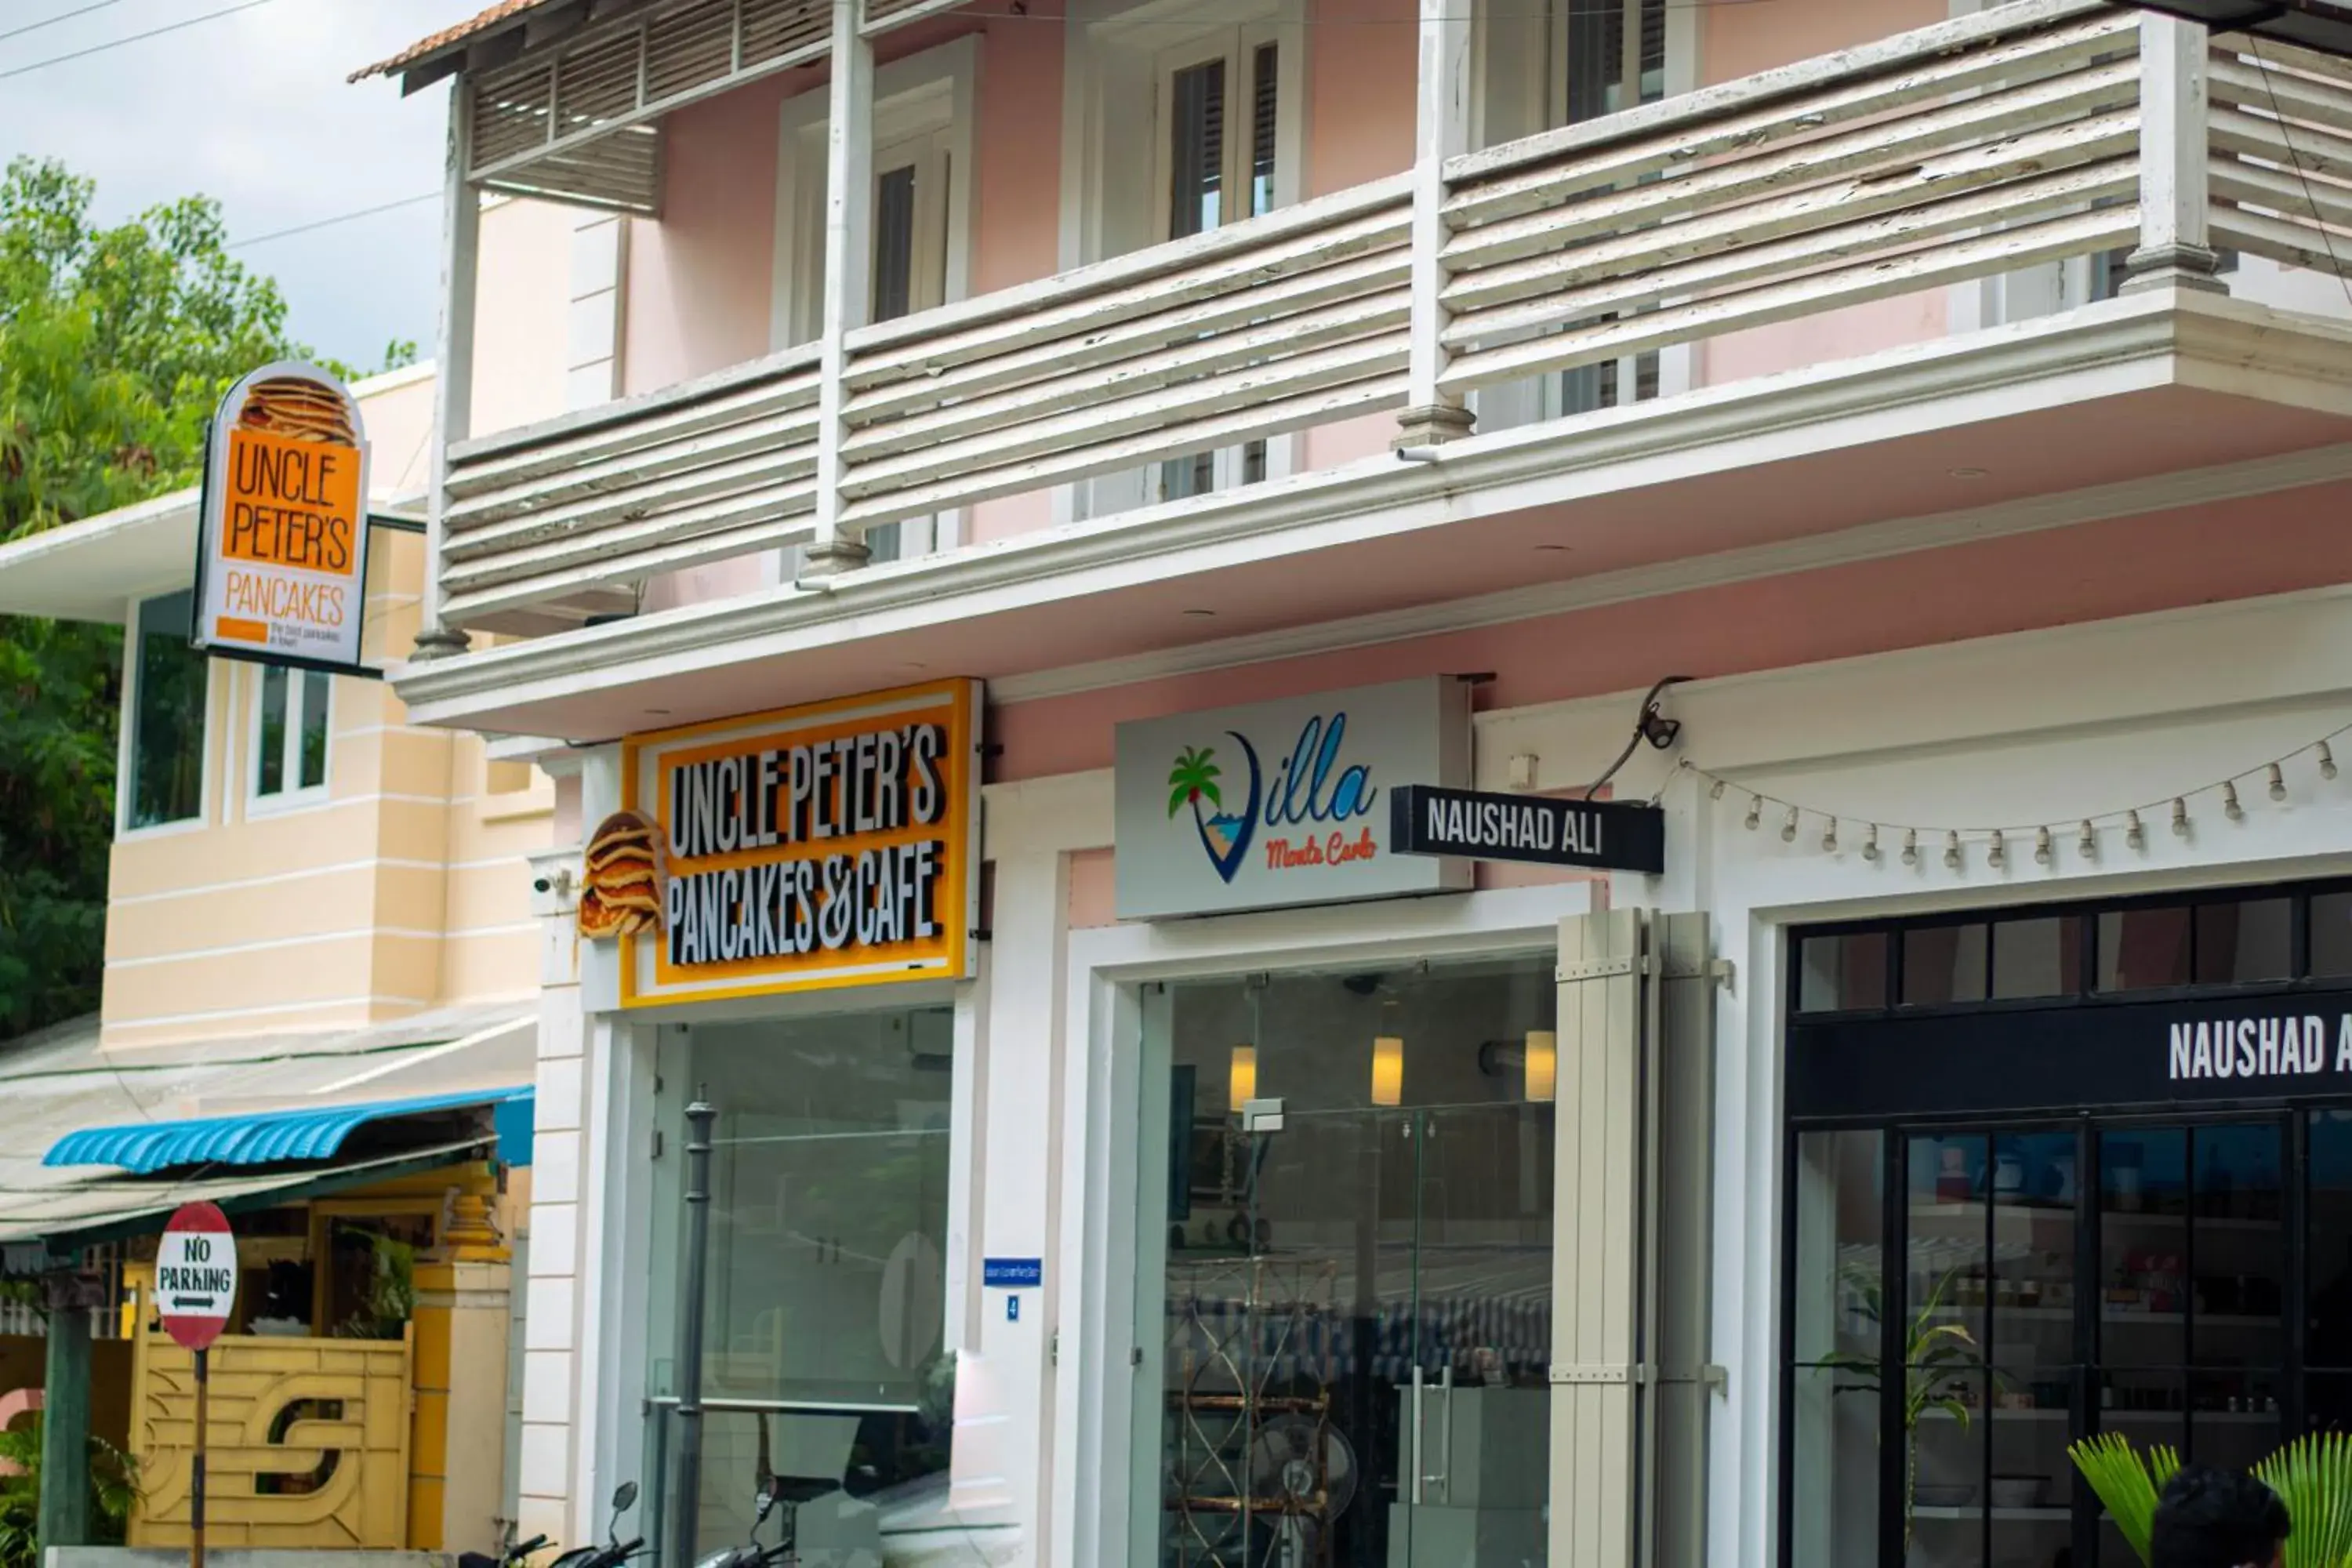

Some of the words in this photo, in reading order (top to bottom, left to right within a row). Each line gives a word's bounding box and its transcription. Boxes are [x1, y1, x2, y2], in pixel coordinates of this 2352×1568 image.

[236, 441, 337, 507] UNCLE
[230, 501, 349, 570] PETER'S
[224, 571, 345, 628] PANCAKES
[670, 750, 782, 858] UNCLE
[789, 723, 939, 842] PETER'S
[1428, 797, 1555, 851] NAUSHAD
[1561, 810, 1602, 855] ALI
[667, 859, 814, 965] PANCAKES
[818, 854, 851, 949] &
[856, 840, 934, 946] CAFE
[2169, 1015, 2325, 1080] NAUSHAD
[159, 1266, 231, 1293] PARKING
[184, 1238, 211, 1263] NO
